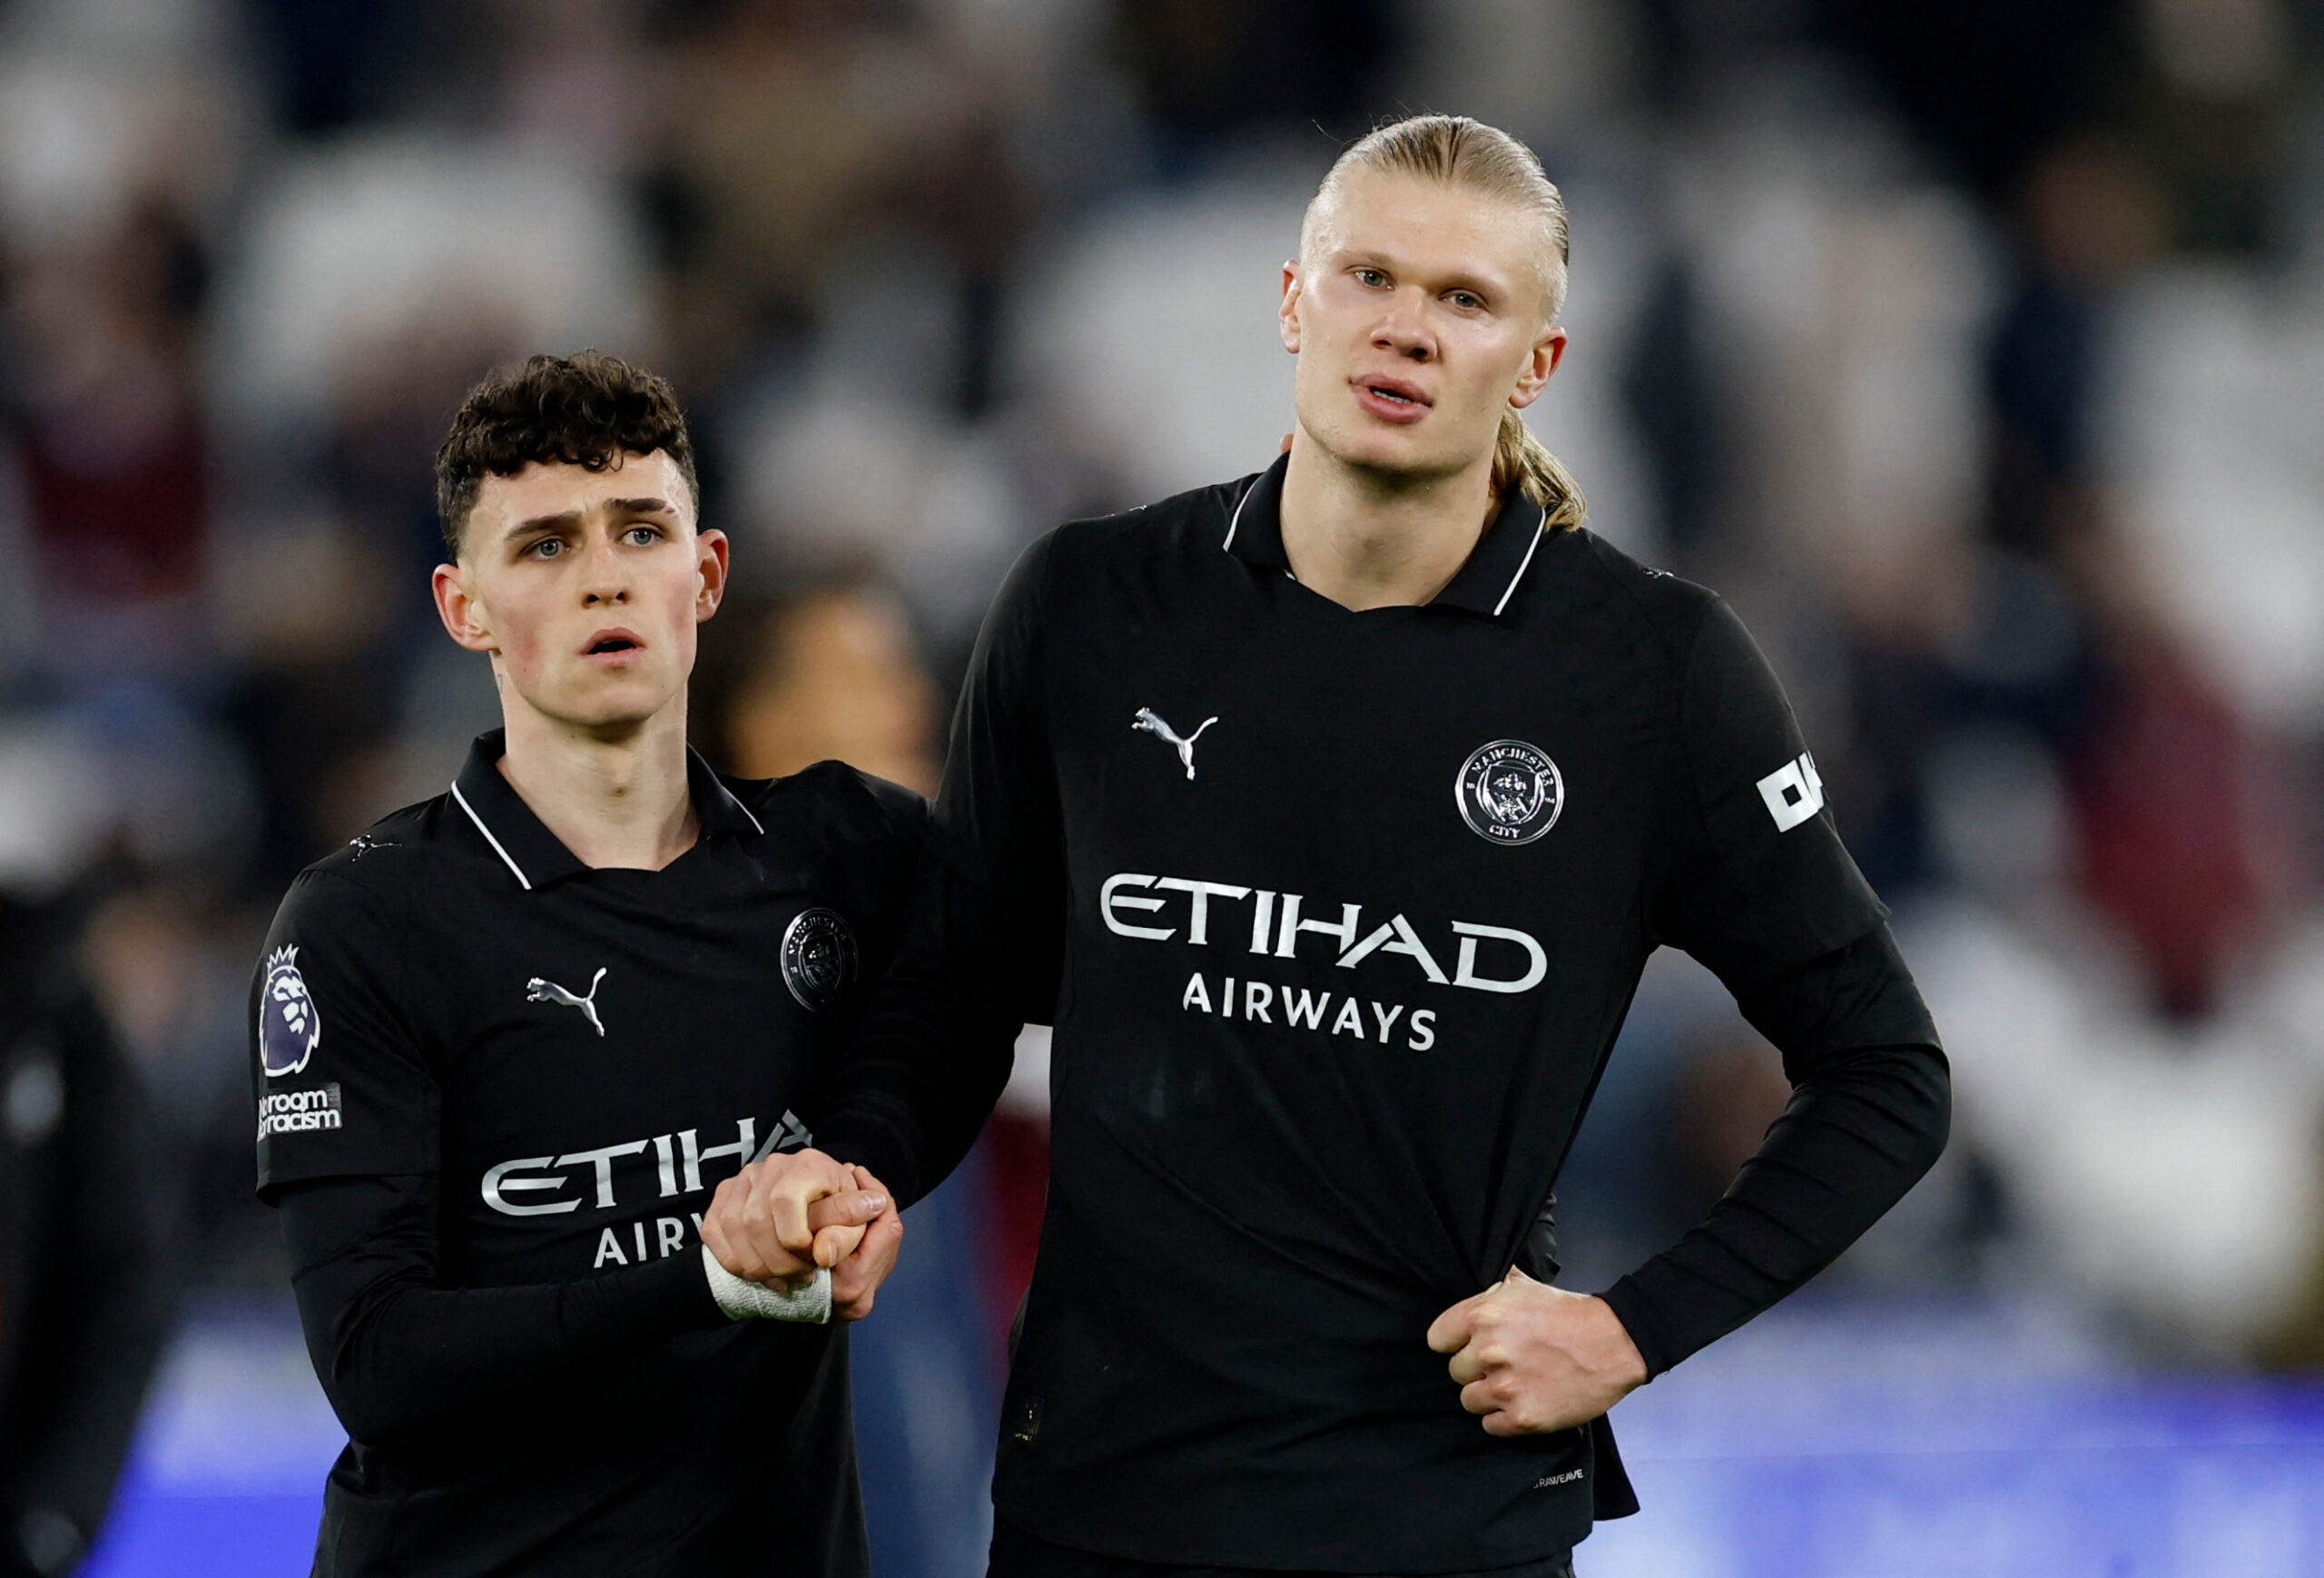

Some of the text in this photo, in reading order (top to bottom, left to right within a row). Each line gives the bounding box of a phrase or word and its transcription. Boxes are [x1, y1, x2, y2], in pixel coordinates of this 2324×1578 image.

[1471, 748, 1554, 787] MANCHESTER
[1489, 824, 1521, 839] CITY
[1099, 873, 1548, 994] ETIHAD
[1182, 972, 1436, 1051] AIRWAYS
[267, 1090, 328, 1114] room
[267, 1109, 340, 1134] racism
[481, 1109, 812, 1217] ETIHA
[593, 1212, 704, 1269] AIR
